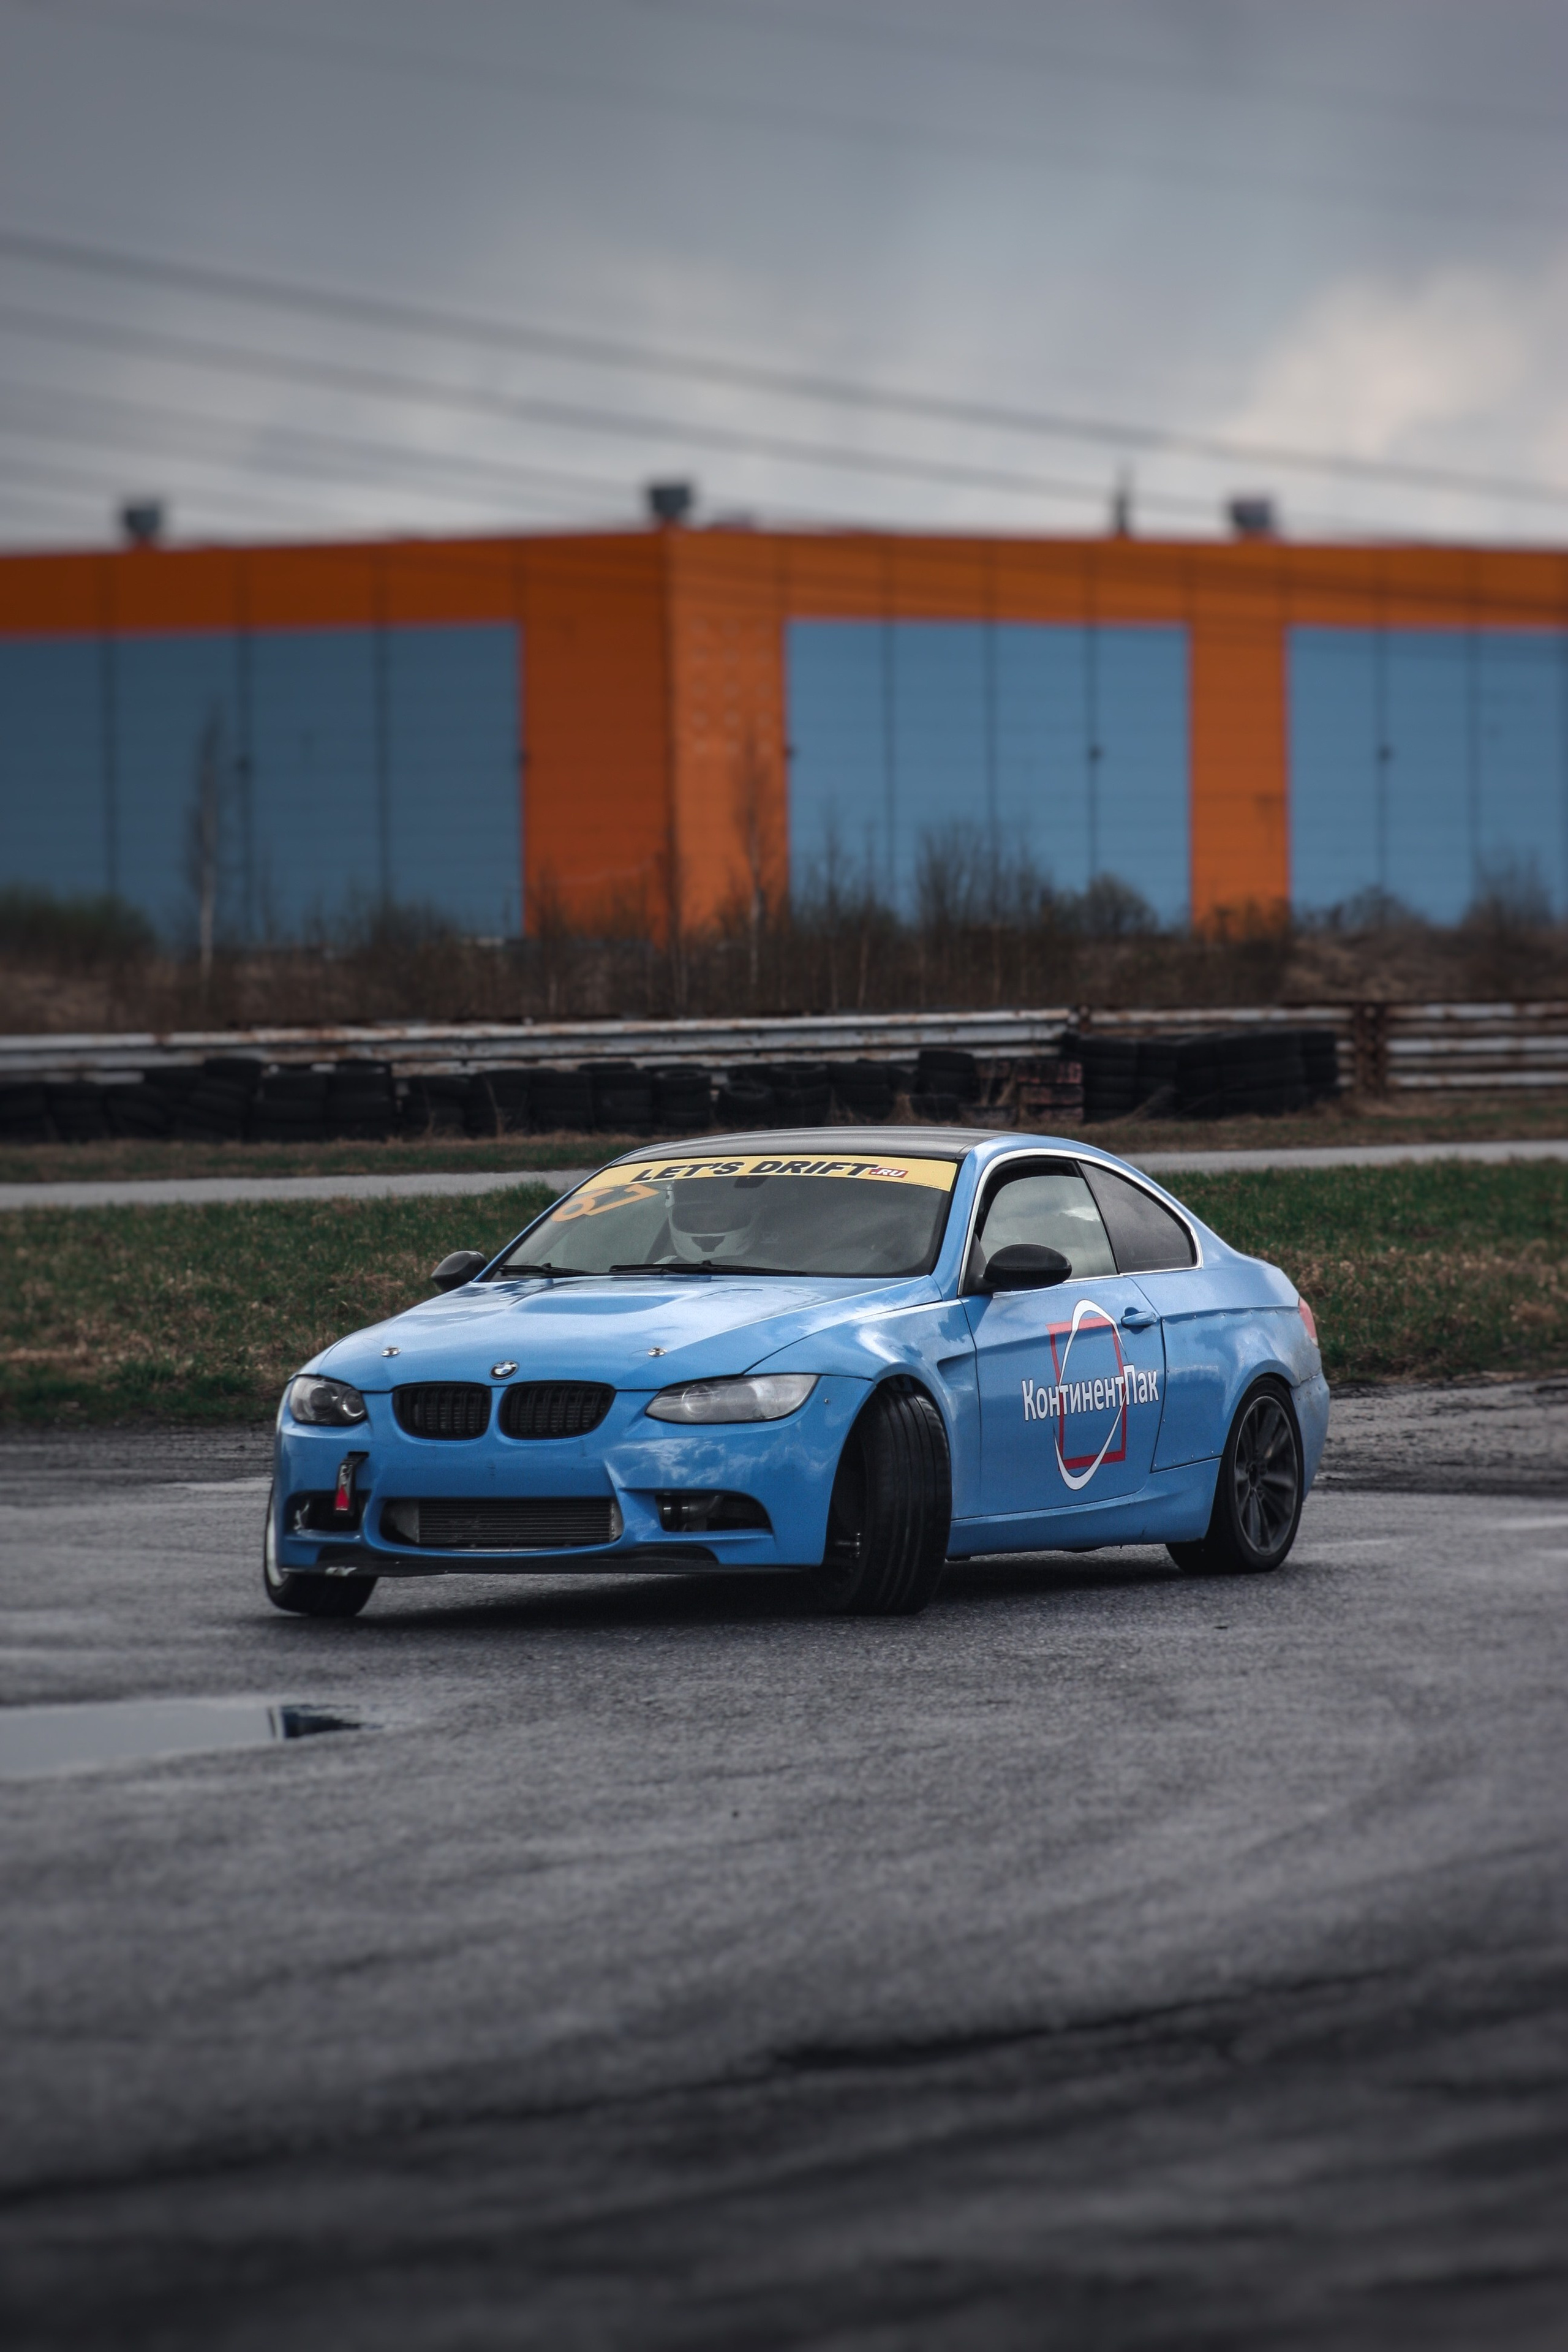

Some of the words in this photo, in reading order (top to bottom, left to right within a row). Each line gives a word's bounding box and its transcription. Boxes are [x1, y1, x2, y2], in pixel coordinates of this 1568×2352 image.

[630, 1161, 745, 1183] LET'S
[551, 1183, 660, 1222] 67
[1022, 1363, 1159, 1421] КонтинентПак
